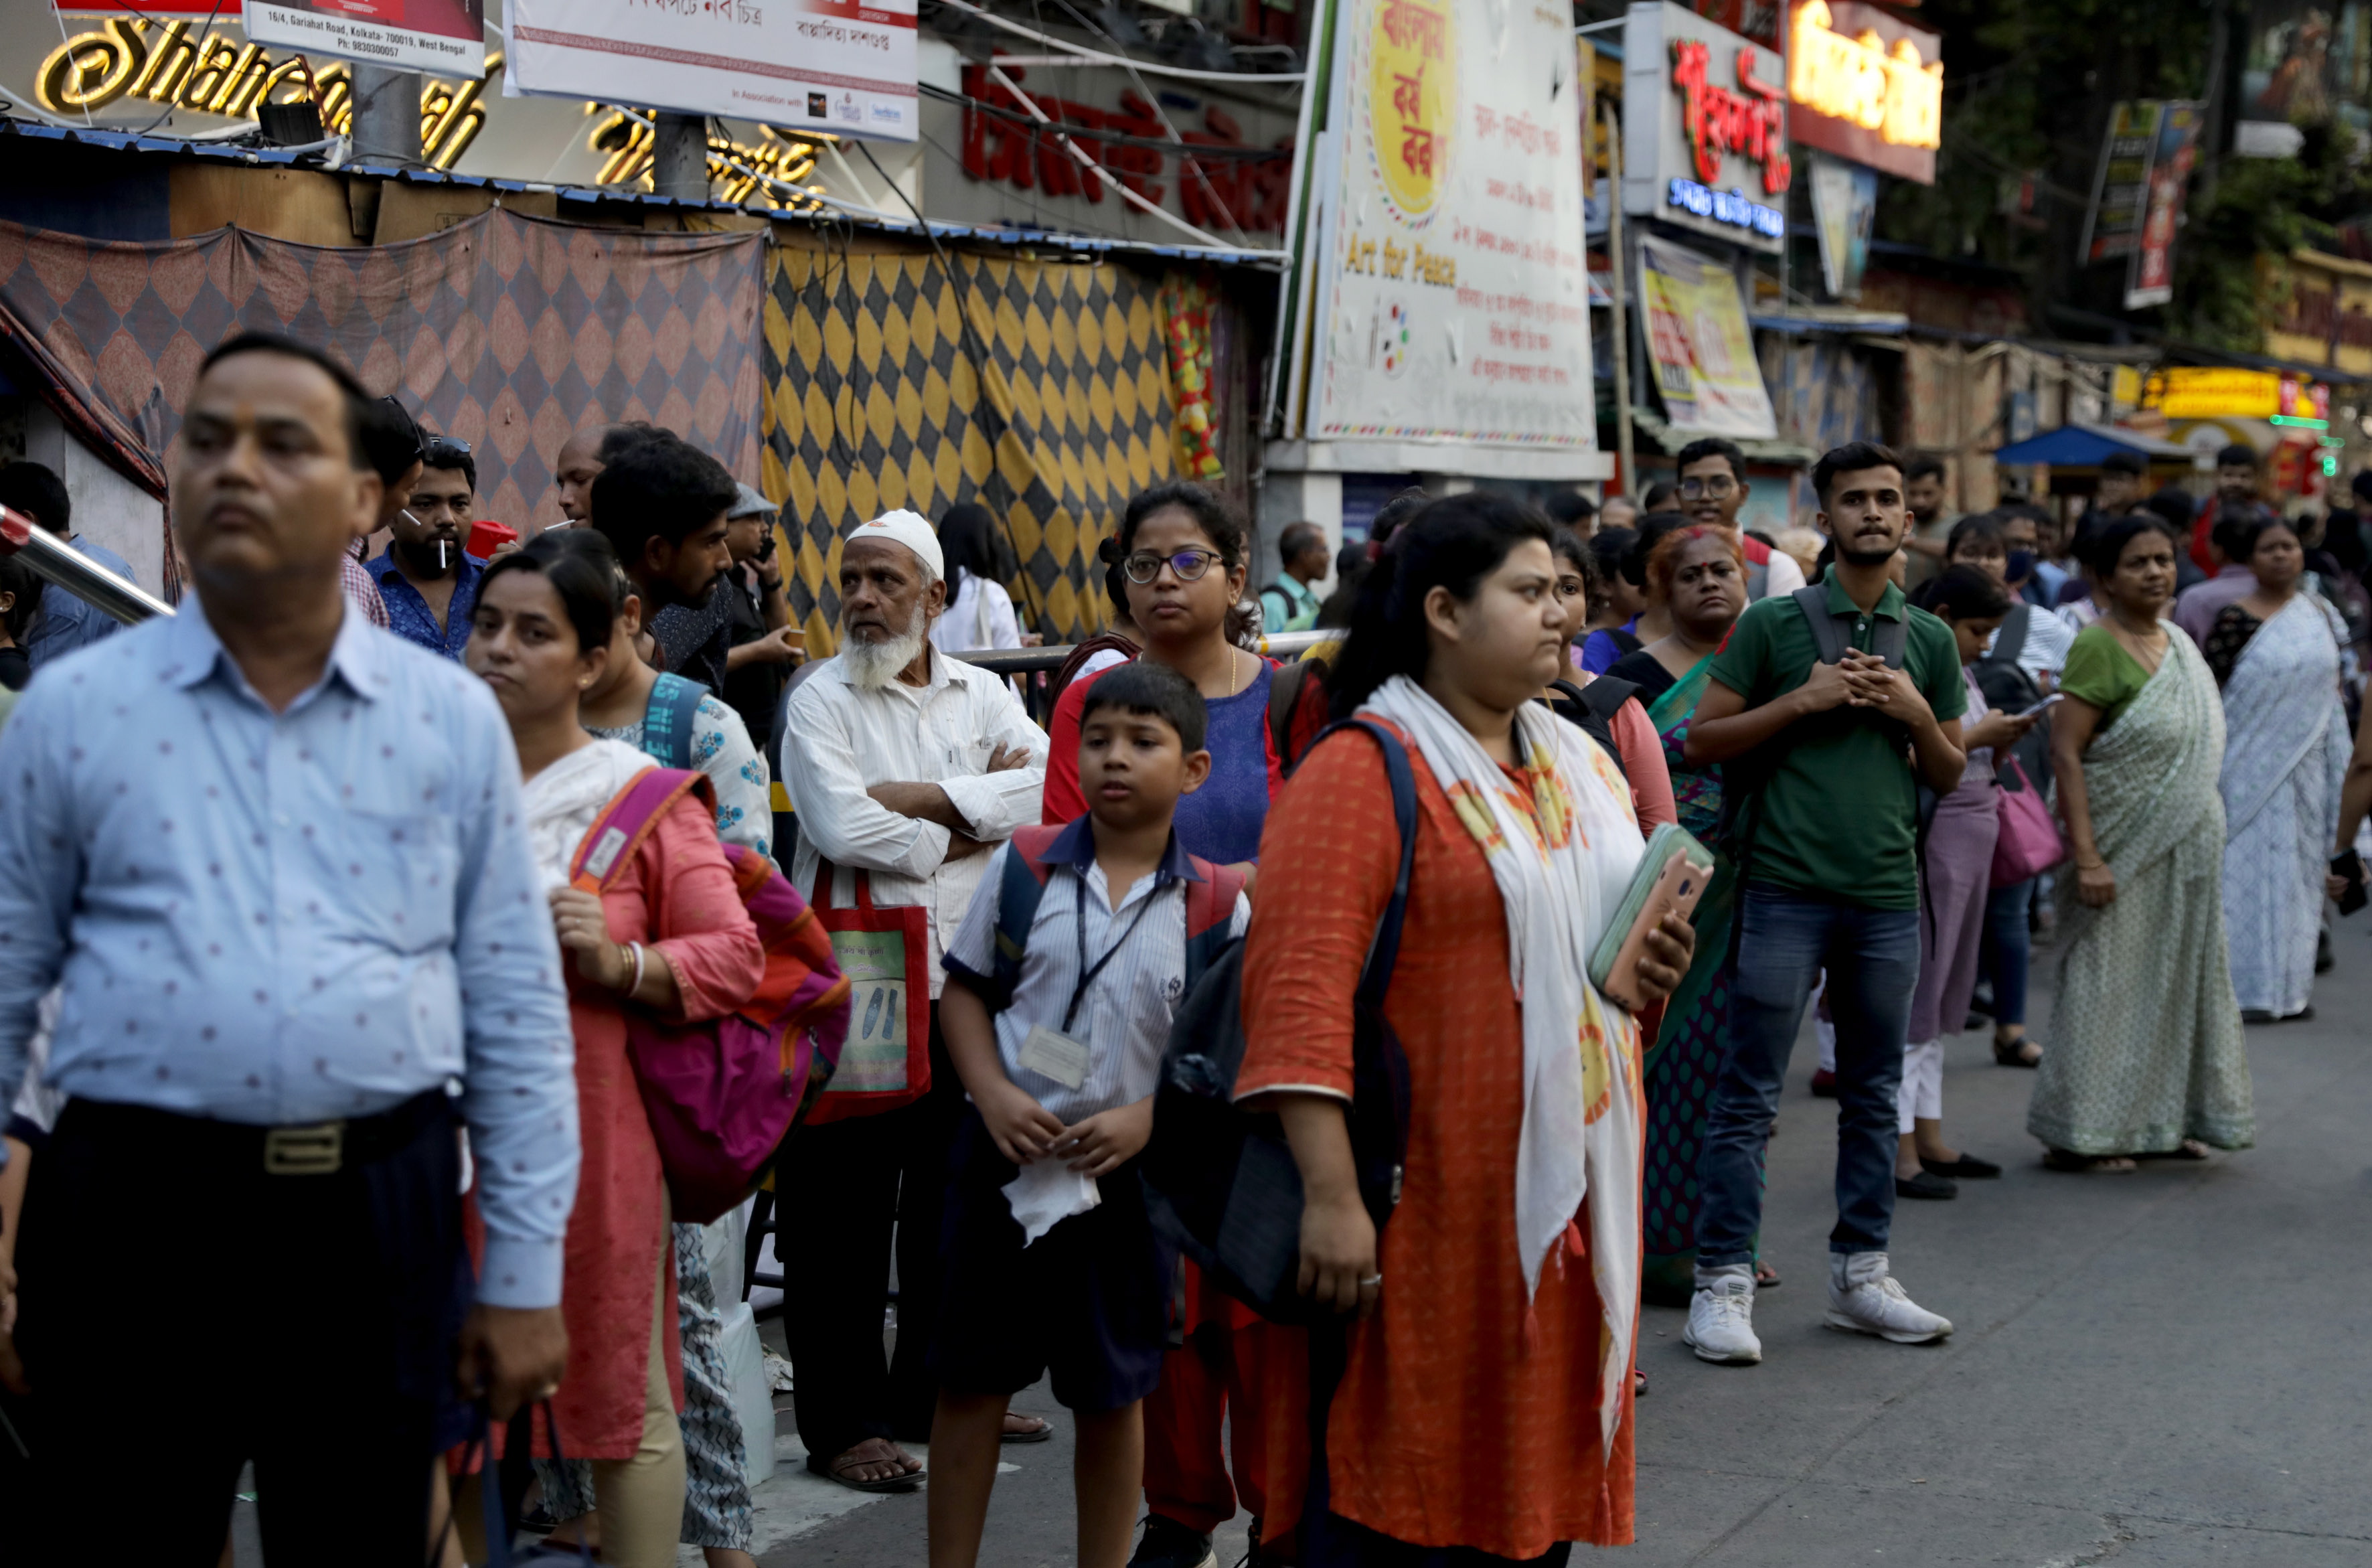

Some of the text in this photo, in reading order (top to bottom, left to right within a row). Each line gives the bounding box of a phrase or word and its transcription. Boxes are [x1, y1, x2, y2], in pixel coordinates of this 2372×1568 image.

[268, 11, 466, 56] 16/4, Gariahat Road, Kolkata- 700019, West Bengal
[337, 38, 399, 58] Ph: 9830300057
[732, 89, 804, 108] In Association with
[1344, 231, 1378, 277] Art
[1382, 236, 1408, 282] for
[1413, 242, 1457, 289] Peace
